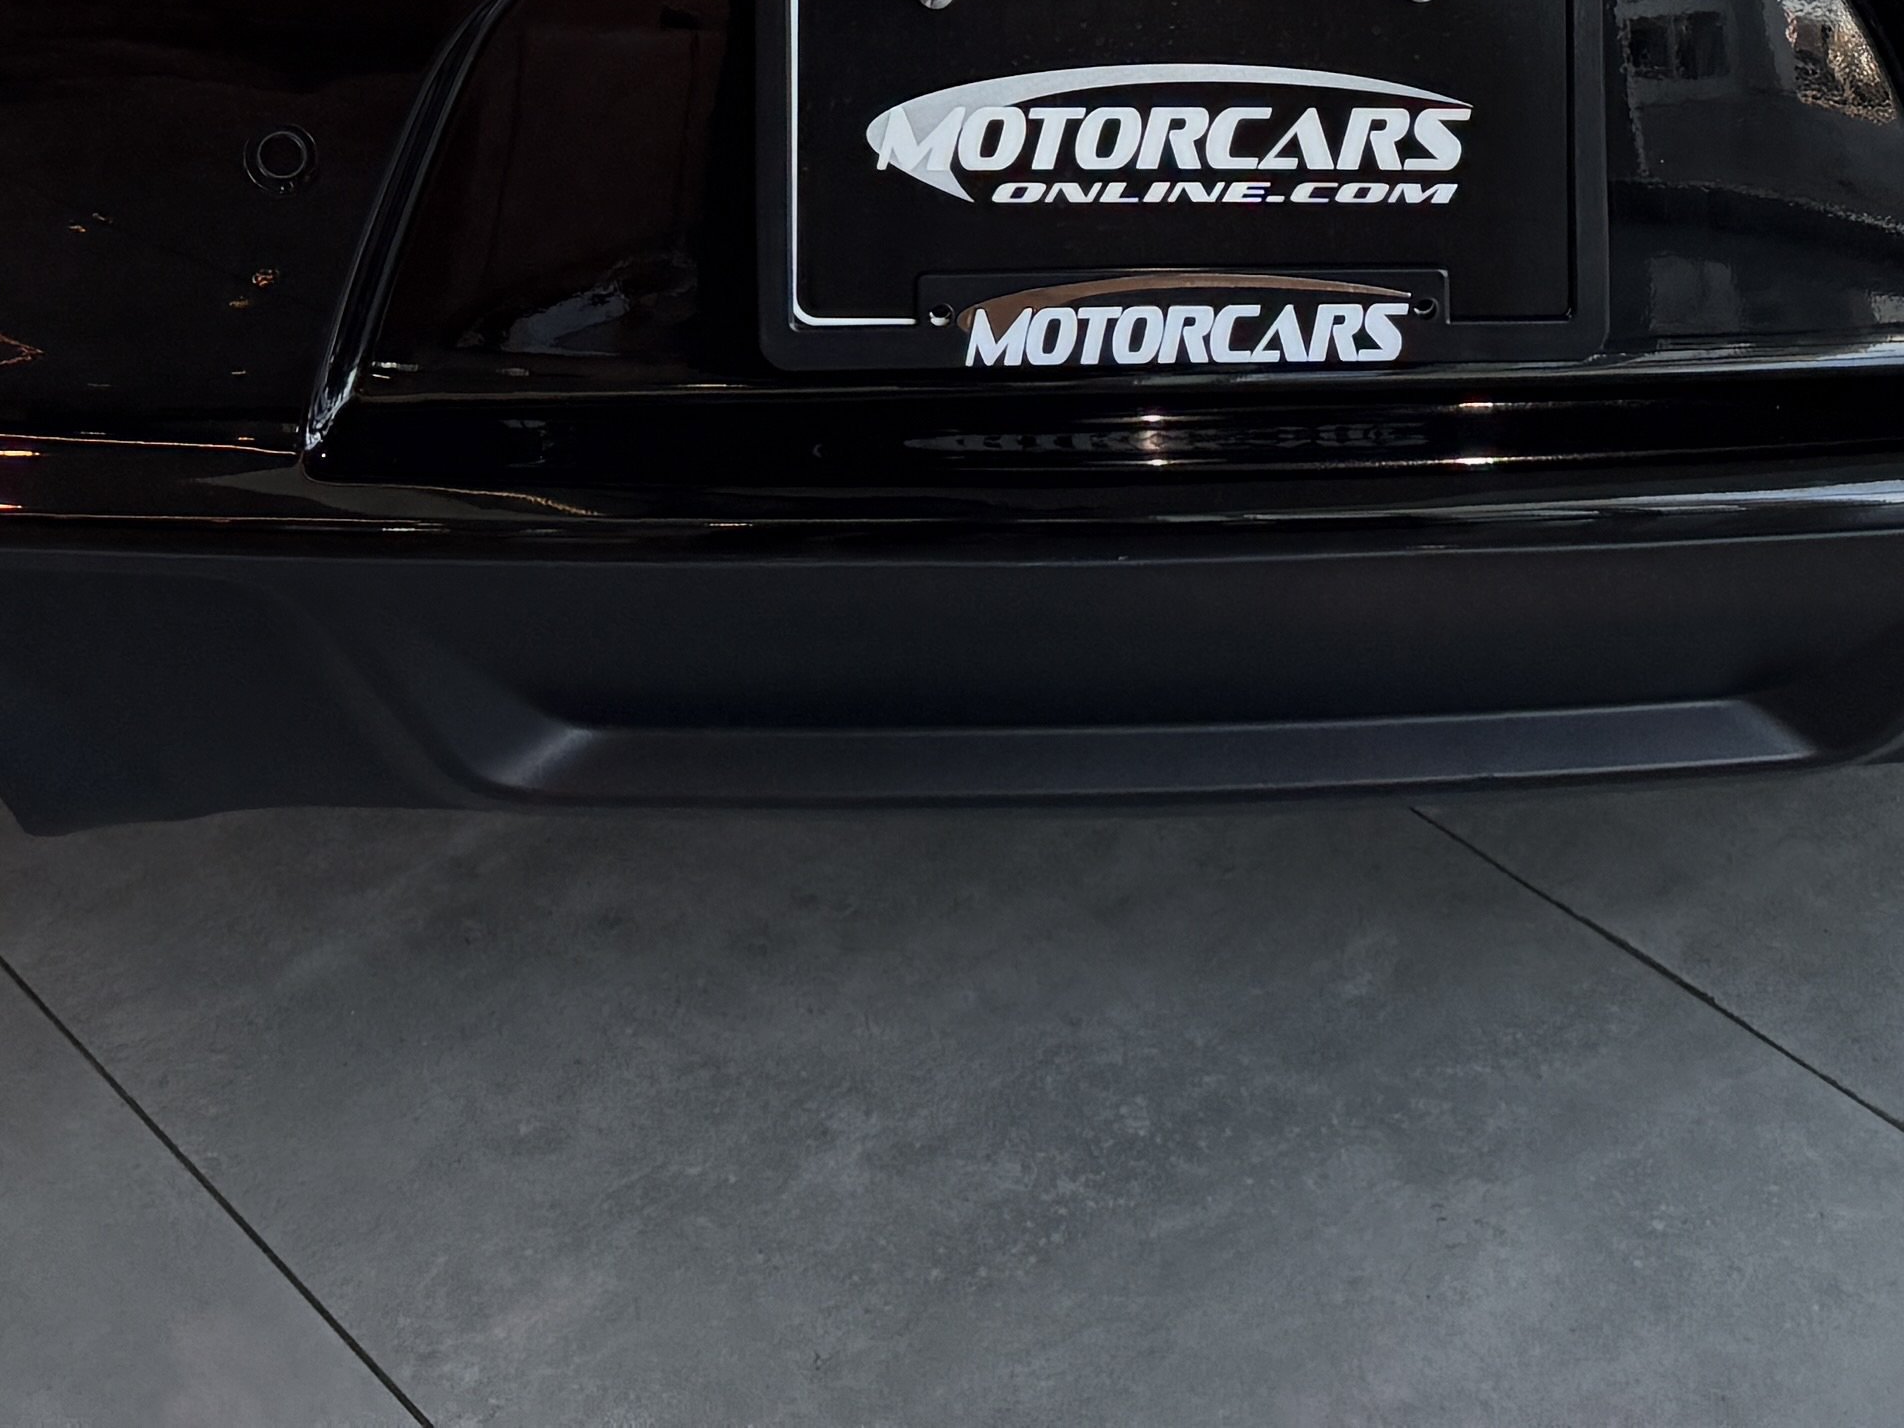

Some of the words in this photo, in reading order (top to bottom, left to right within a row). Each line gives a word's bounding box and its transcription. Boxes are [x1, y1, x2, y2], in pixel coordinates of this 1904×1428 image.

[876, 106, 1472, 171] MOTORCARS
[991, 180, 1459, 205] ONLINE.COM
[964, 302, 1410, 367] MOTORCARS
